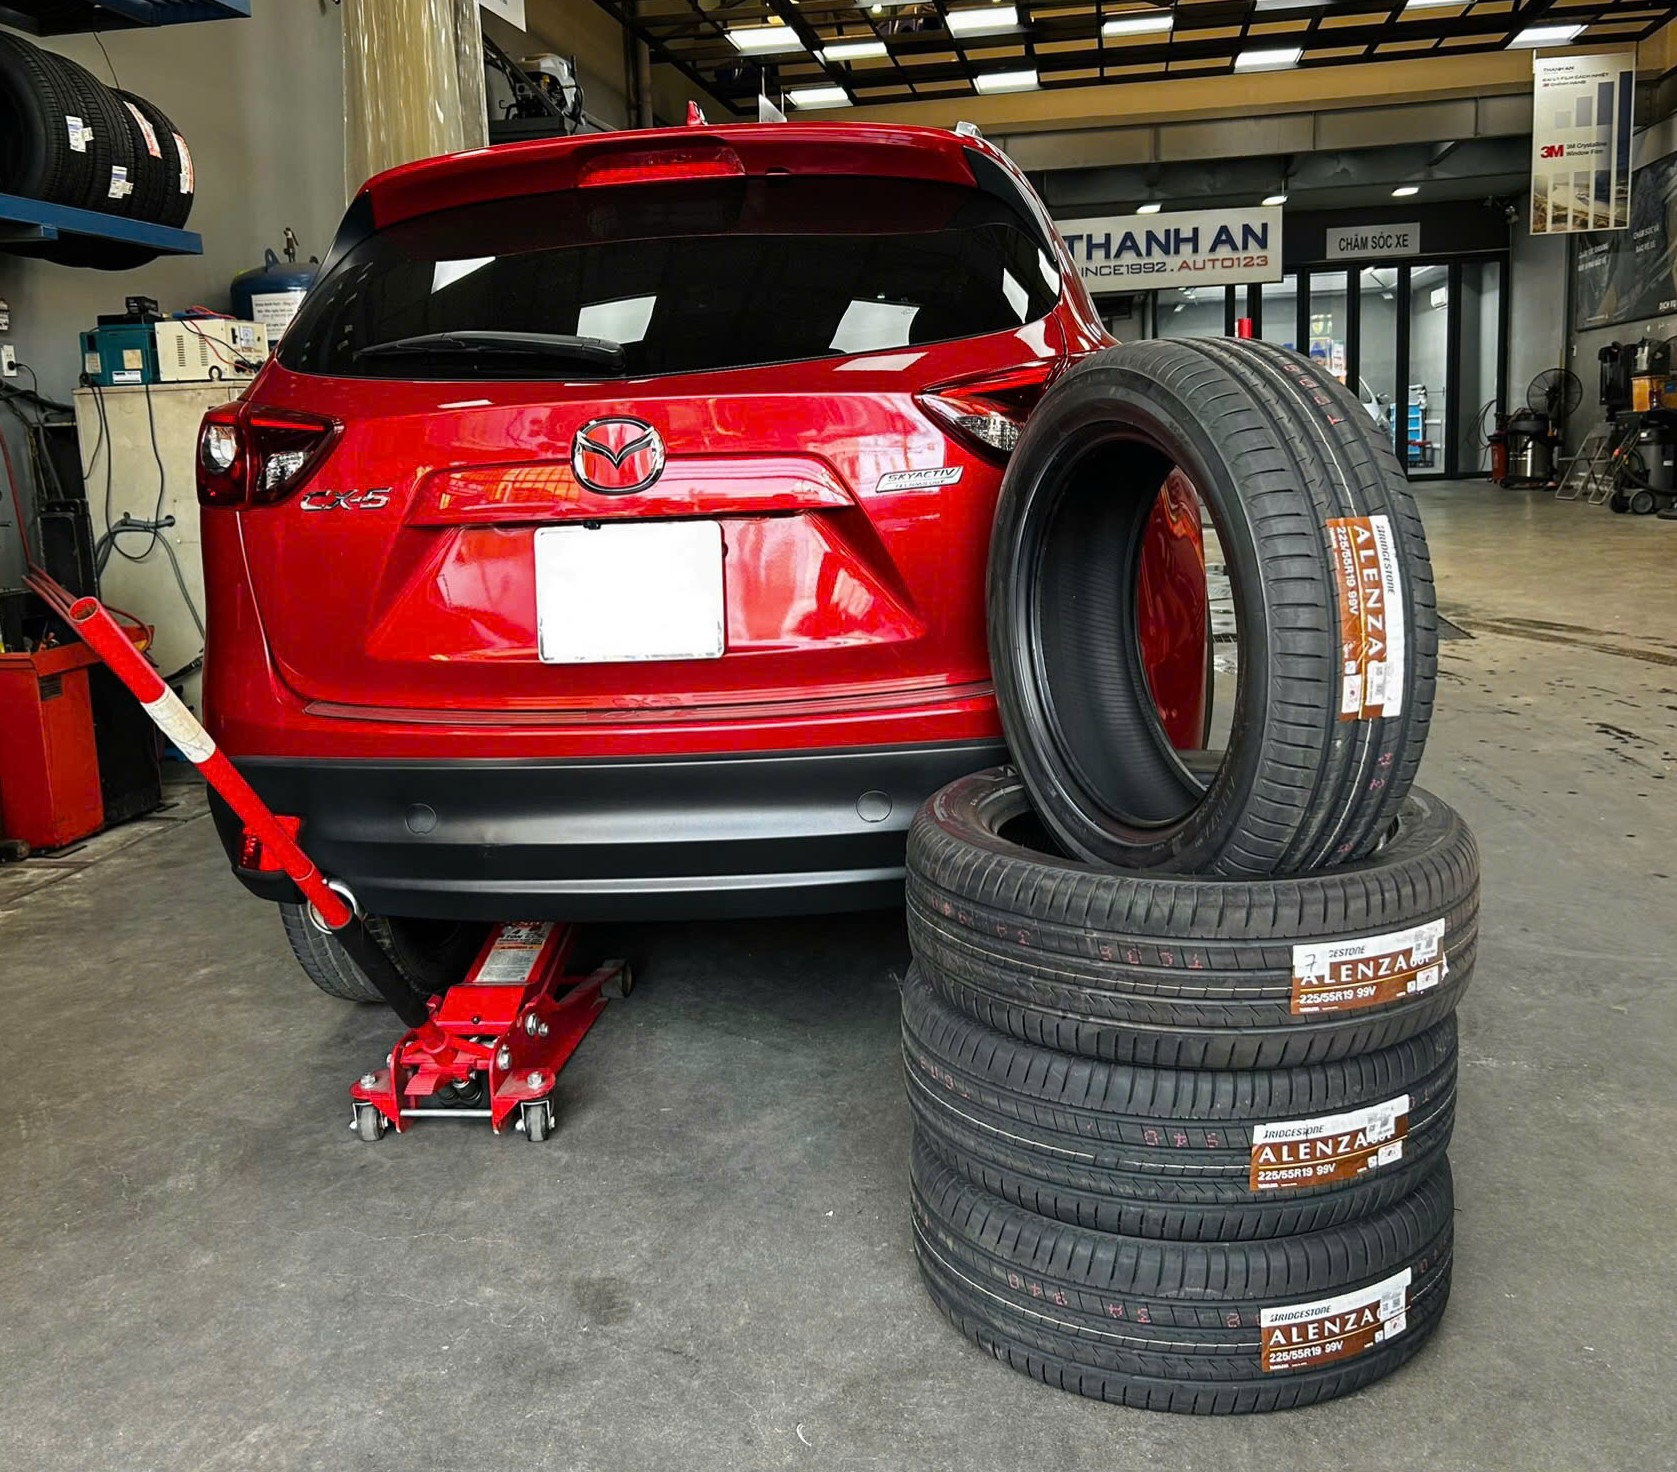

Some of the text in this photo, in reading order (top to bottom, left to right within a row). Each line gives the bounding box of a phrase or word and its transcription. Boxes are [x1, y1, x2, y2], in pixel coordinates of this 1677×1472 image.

[1540, 145, 1564, 159] 3M
[1062, 222, 1269, 261] THANH AN
[1371, 232, 1393, 249] SÓC
[1395, 234, 1409, 248] XE
[889, 469, 955, 481] SKYACTIV
[300, 487, 393, 511] CX-5
[1353, 525, 1383, 656] ALENZA
[1345, 589, 1359, 615] 99V
[1299, 985, 1377, 1004] 225/55R19 99V
[1263, 1124, 1325, 1139] BRIDGESTONE
[1258, 1132, 1369, 1163] ALENZA
[1258, 1163, 1337, 1181] 225/55R19 99V
[1269, 1304, 1332, 1322] BRIDGESTONE
[1269, 1308, 1374, 1346] ALENZA
[1269, 1340, 1344, 1363] 225/55R19 99V
